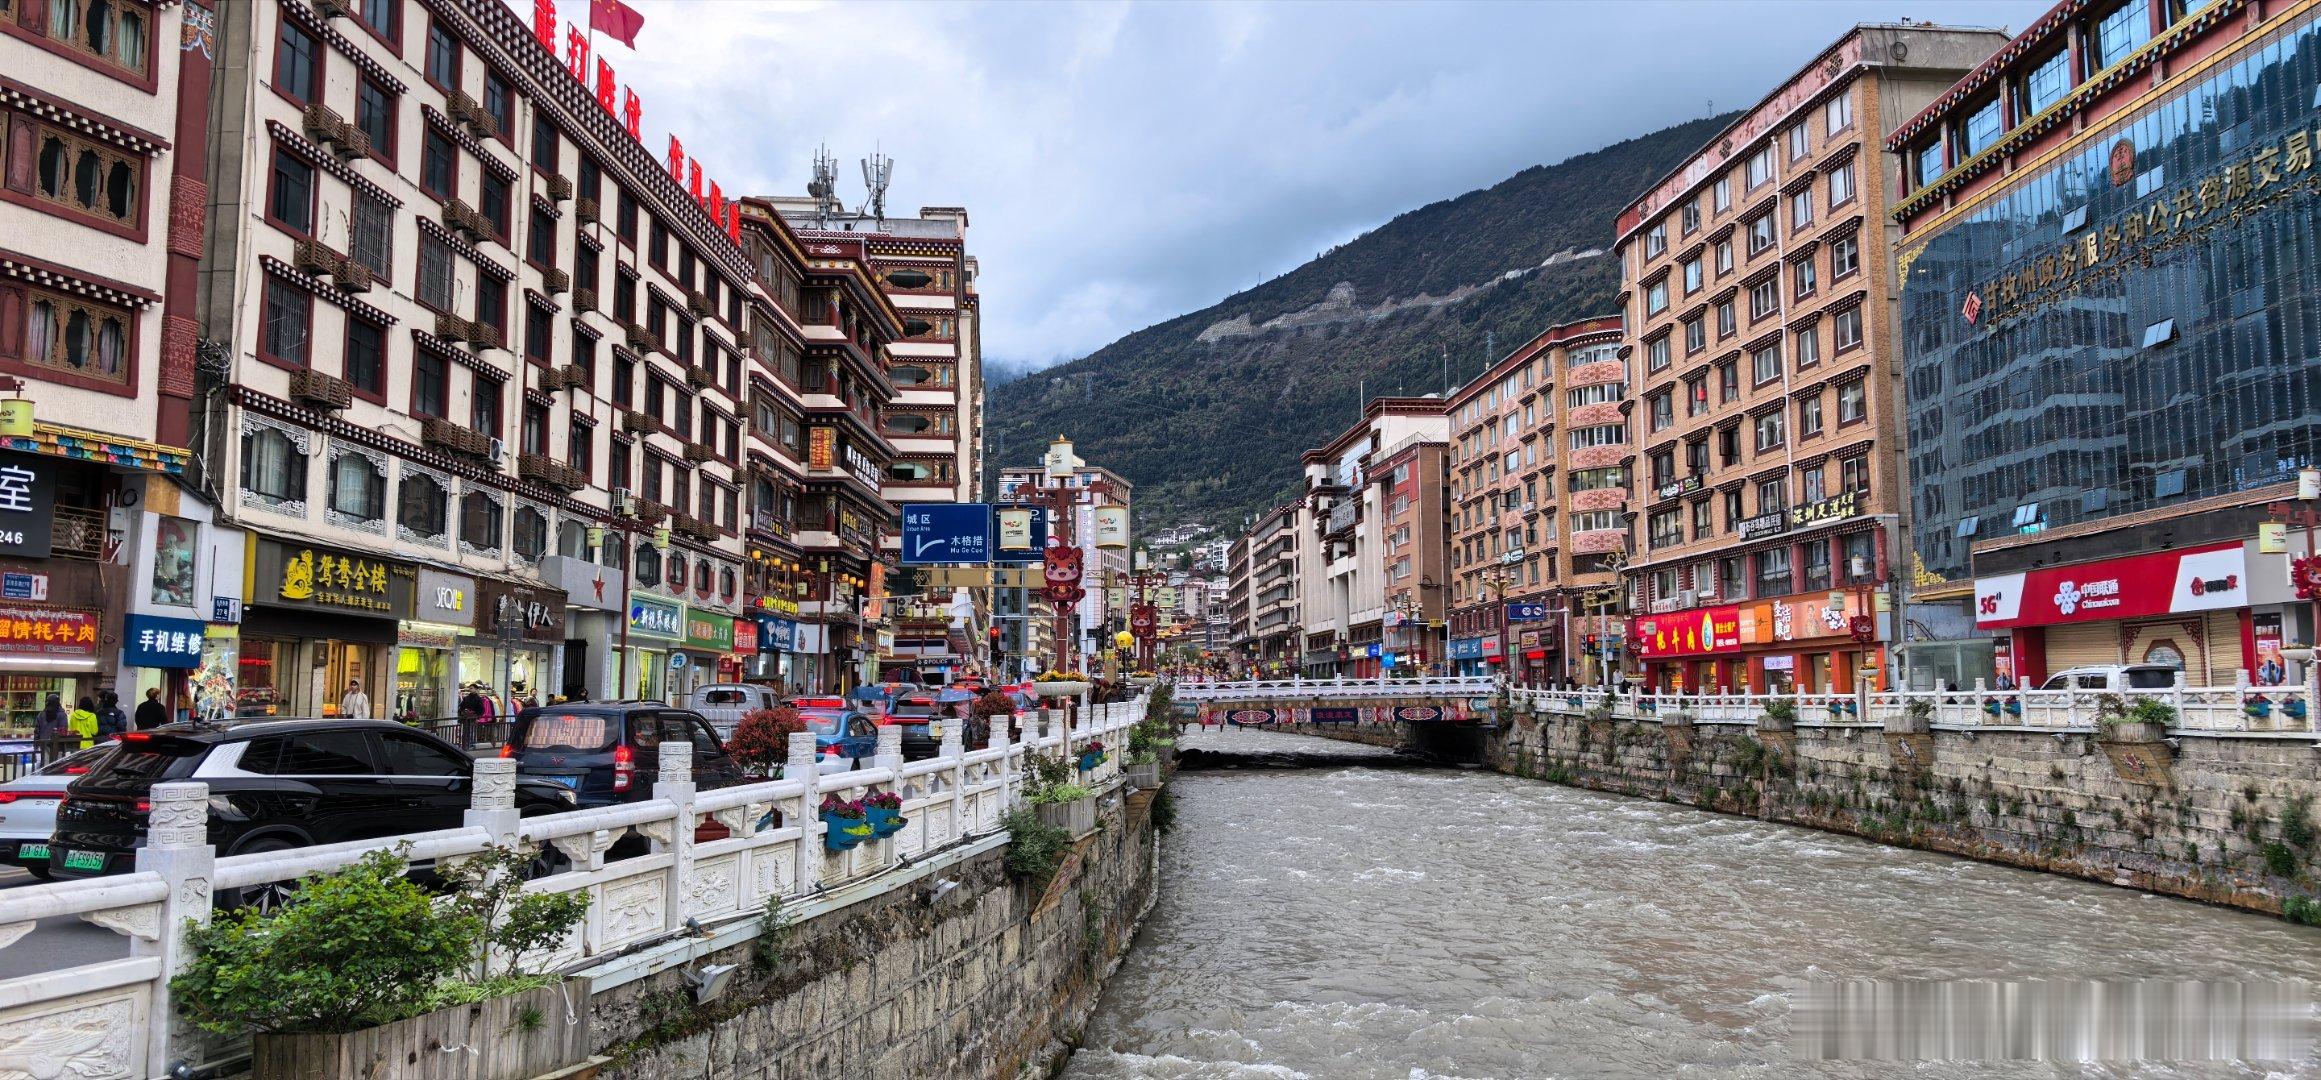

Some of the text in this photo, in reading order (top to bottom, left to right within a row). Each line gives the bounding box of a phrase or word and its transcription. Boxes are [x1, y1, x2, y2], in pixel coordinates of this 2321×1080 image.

[1984, 129, 2321, 311] 甘孜州政务服务和公共资源交易
[0, 465, 35, 511] 室
[907, 514, 930, 524] 城区
[950, 536, 983, 546] 木格措
[318, 554, 387, 594] 鸳鸯金楼
[2081, 579, 2119, 597] 中国联通
[140, 630, 202, 655] 手机维修
